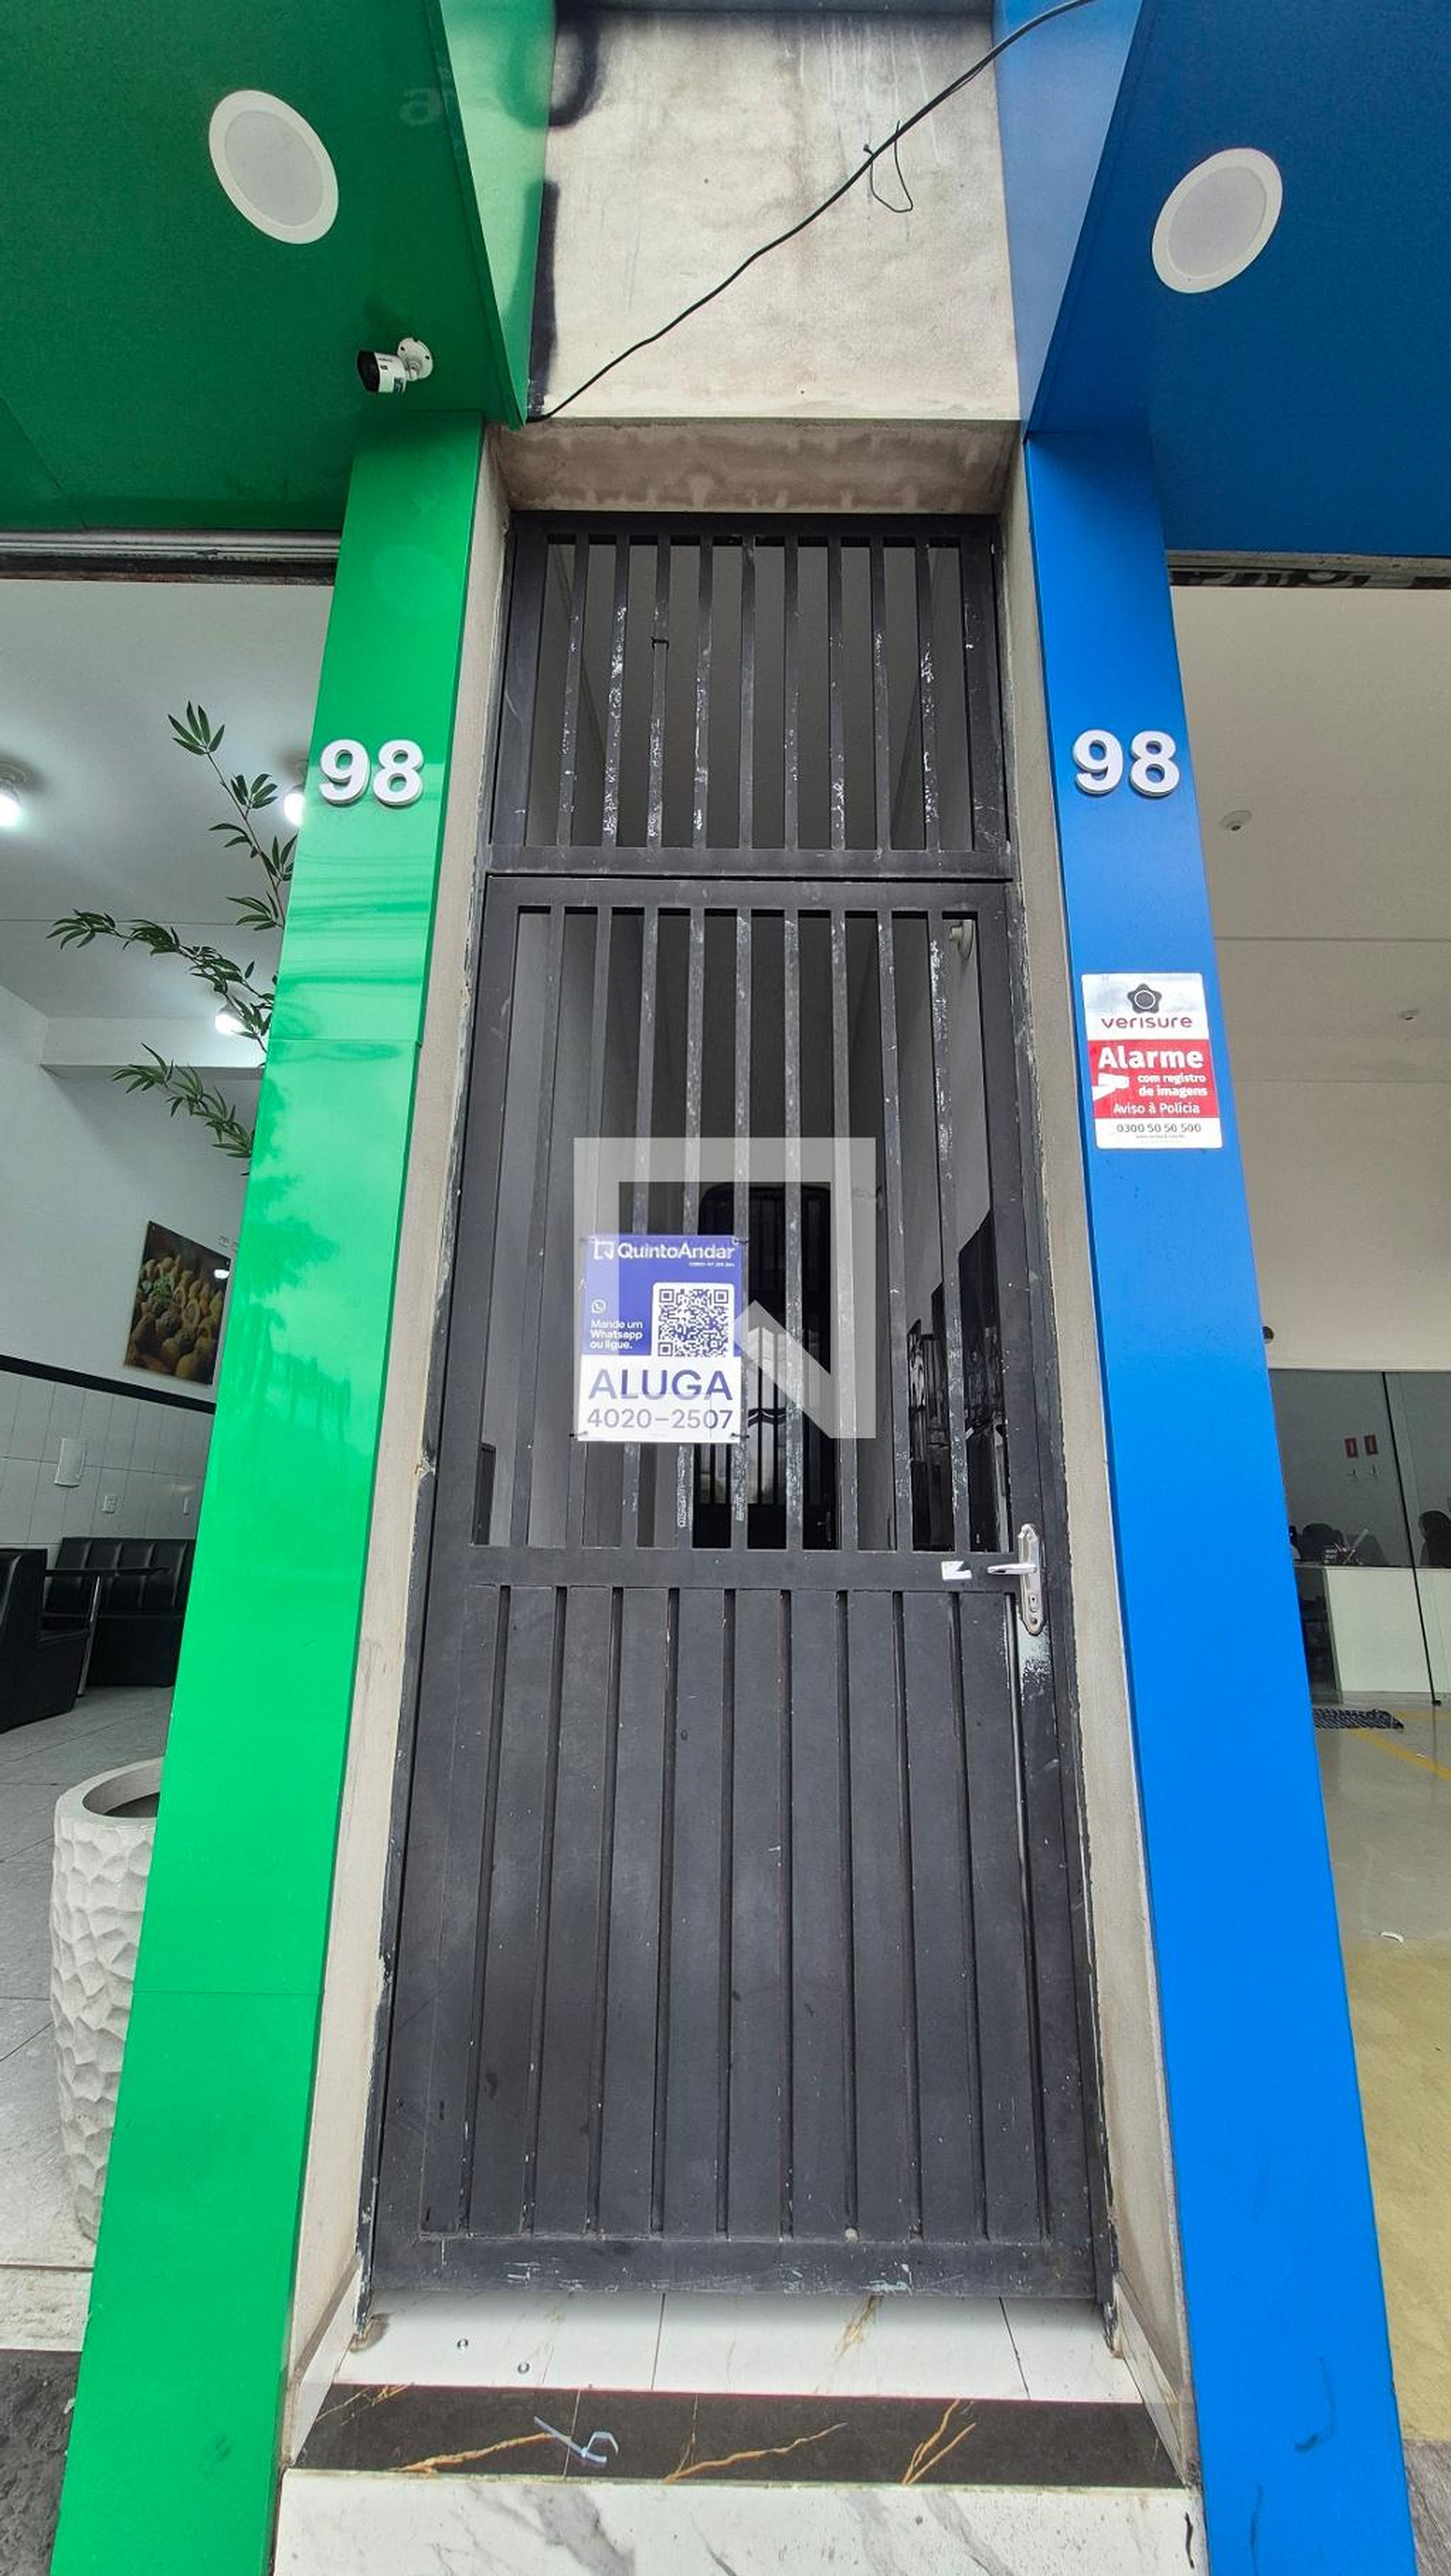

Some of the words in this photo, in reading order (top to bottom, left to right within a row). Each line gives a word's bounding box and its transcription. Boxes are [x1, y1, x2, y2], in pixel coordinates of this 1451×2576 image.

[1072, 729, 1179, 797] 98
[319, 739, 424, 807] 98
[1101, 1016, 1193, 1029] verisure
[1098, 1045, 1204, 1069] Alarme
[1163, 1072, 1207, 1084] registro
[1139, 1085, 1154, 1096] de
[1157, 1085, 1208, 1098] imagens
[1113, 1102, 1145, 1114] Aviso
[1149, 1101, 1156, 1113] à
[1159, 1102, 1200, 1113] Polícia
[1117, 1123, 1145, 1133] 0300
[1147, 1123, 1161, 1133] 50
[1164, 1123, 1178, 1133] 50
[1181, 1123, 1202, 1133] 500
[617, 1240, 735, 1259] QuintoAndar
[591, 1319, 625, 1328] Mande
[590, 1329, 643, 1341] Whatsapp
[605, 1340, 633, 1351] ligue.
[588, 1369, 733, 1400] ALUGA
[586, 1409, 733, 1429] 4020-2507
